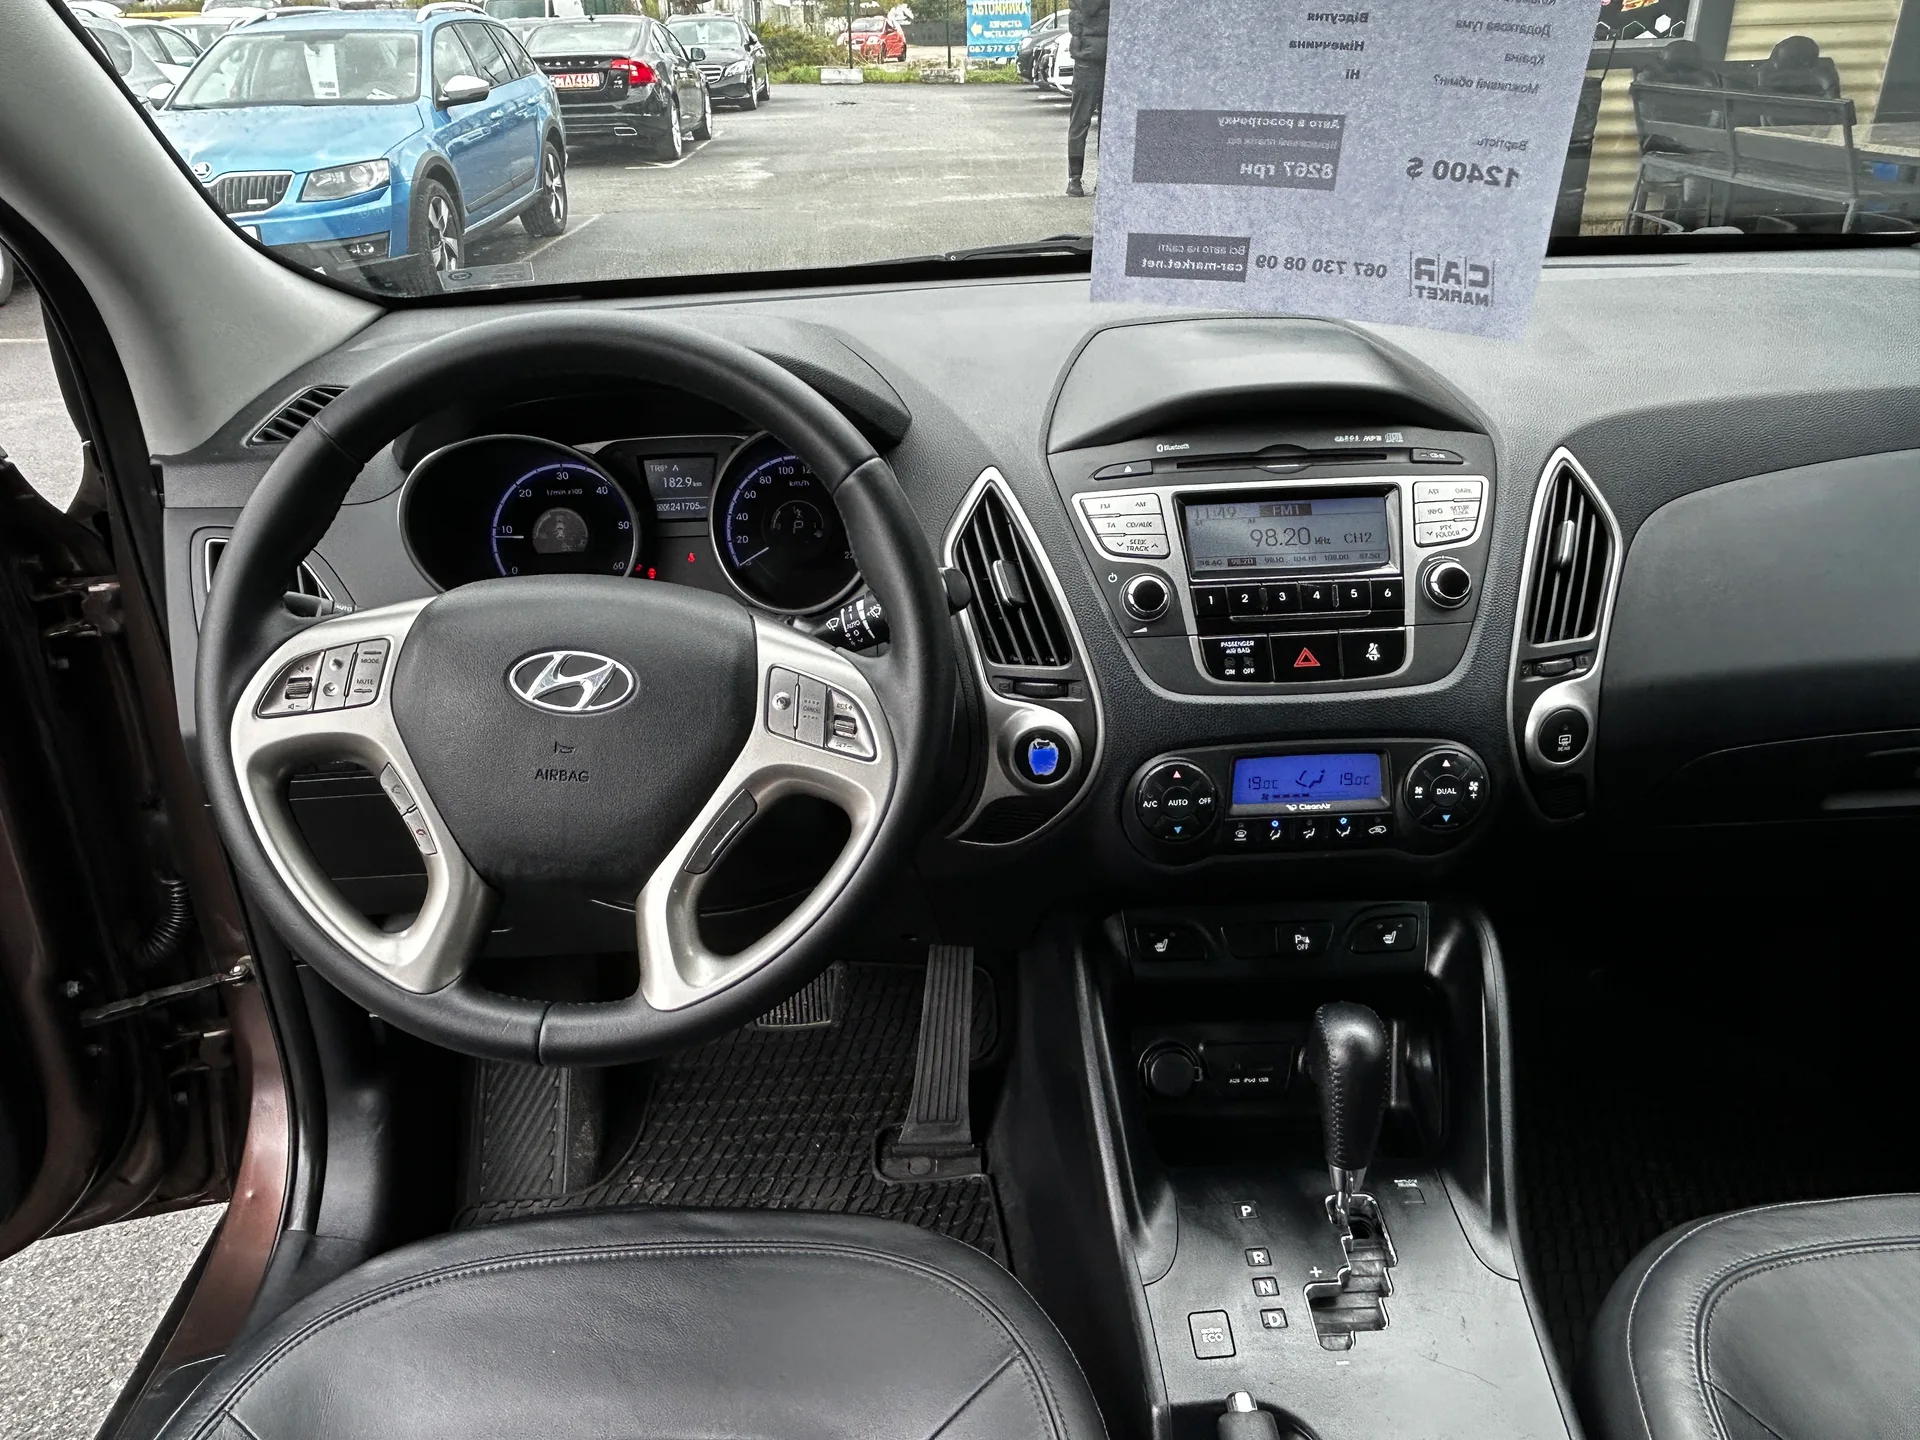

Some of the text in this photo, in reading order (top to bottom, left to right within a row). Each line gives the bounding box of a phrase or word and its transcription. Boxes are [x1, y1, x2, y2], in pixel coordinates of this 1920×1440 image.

[778, 466, 794, 475] 100
[802, 465, 812, 474] 12
[556, 471, 569, 480] 30
[759, 475, 772, 485] 80
[663, 477, 692, 488] 182.9
[519, 488, 532, 498] 20
[596, 485, 608, 495] 40
[744, 490, 756, 499] 60
[1272, 504, 1300, 516] FM1
[736, 512, 748, 521] 40
[501, 525, 513, 534] 10
[618, 521, 630, 530] 50
[736, 535, 749, 544] 20
[1250, 527, 1311, 548] 98.20
[1343, 532, 1372, 543] CH2
[612, 561, 625, 570] 60
[1208, 588, 1391, 605] 1 2 3 4 5 6
[1221, 640, 1254, 648] PASSENGER
[534, 768, 590, 782] AIRBAG
[1436, 787, 1457, 795] DUAL
[1143, 800, 1158, 808] A/C
[1168, 798, 1188, 806] AUTO
[1198, 797, 1211, 805] OFF
[1241, 1205, 1252, 1217] P
[1252, 1251, 1266, 1264] R
[1259, 1280, 1273, 1294] N
[1267, 1312, 1281, 1327] D
[1202, 1333, 1224, 1342] ECO
